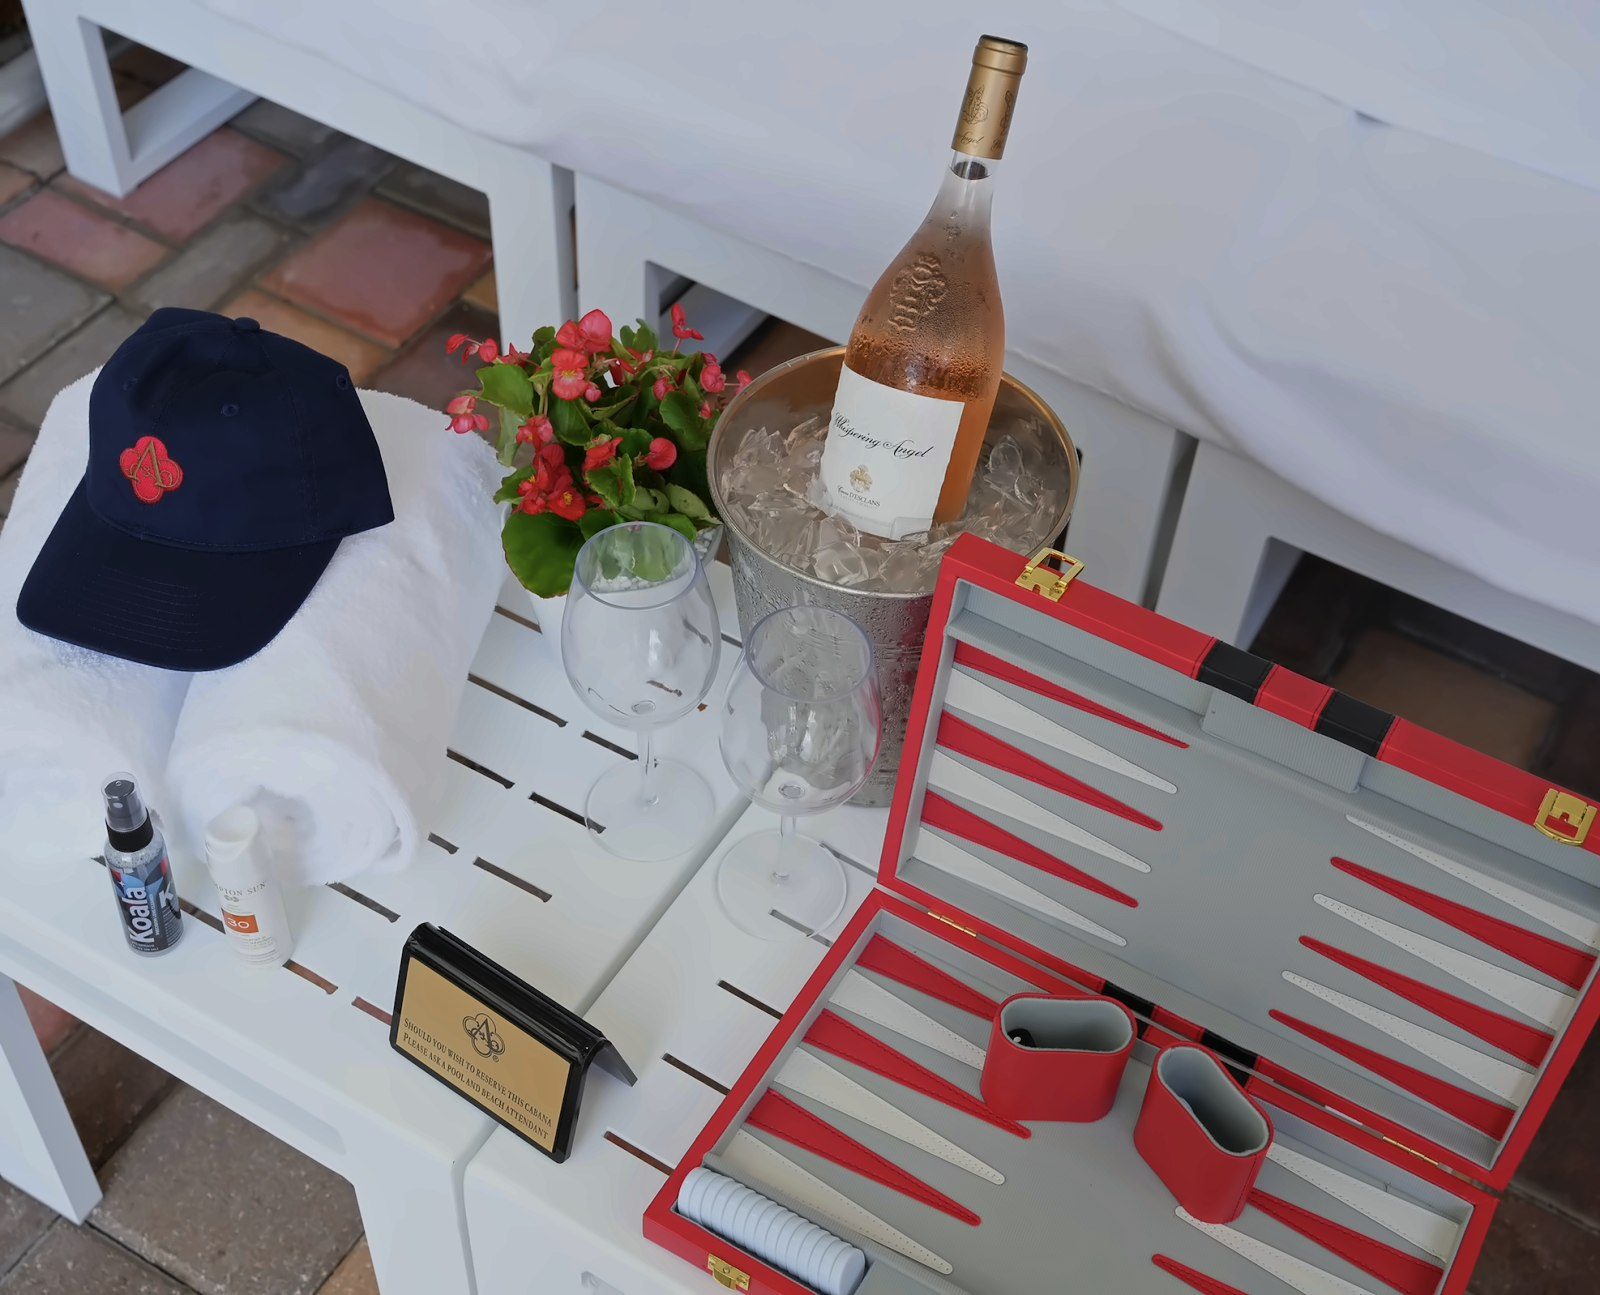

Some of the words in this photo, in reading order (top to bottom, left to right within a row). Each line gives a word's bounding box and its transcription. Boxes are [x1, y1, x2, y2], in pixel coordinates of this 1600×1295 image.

[834, 411, 882, 450] Whispering
[882, 439, 935, 460] Angel
[121, 886, 155, 943] Koala
[226, 917, 250, 929] 30
[403, 1032, 429, 1057] PLEASE
[428, 1052, 441, 1066] ASK
[441, 1061, 446, 1070] A
[446, 1064, 465, 1083] POOL
[465, 1078, 481, 1093] AND
[481, 1088, 505, 1110] BEACH
[504, 1105, 549, 1140] ATTENDANT
[404, 1018, 432, 1044] SHOULD
[432, 1038, 447, 1054] YOU
[447, 1049, 465, 1067] WISH
[466, 1061, 476, 1074] TO
[475, 1068, 507, 1096] RESERVE
[507, 1090, 525, 1108] THIS
[524, 1102, 552, 1128] CABANA
